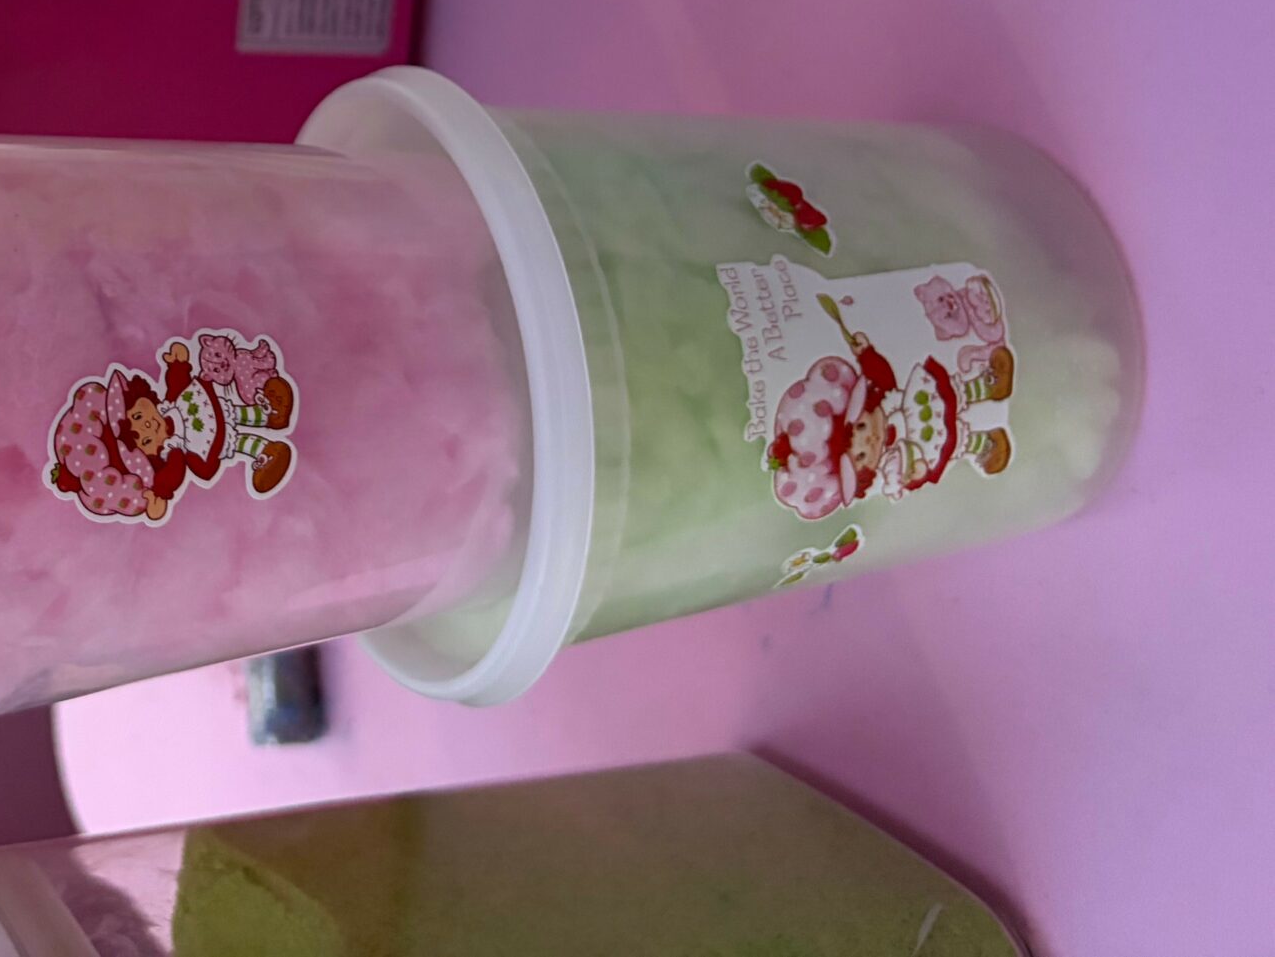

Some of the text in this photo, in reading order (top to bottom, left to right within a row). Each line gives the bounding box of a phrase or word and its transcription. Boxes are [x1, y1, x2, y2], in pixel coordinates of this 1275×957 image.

[750, 268, 789, 361] A Better
[774, 259, 803, 323] Place
[719, 267, 767, 437] Bake the World
